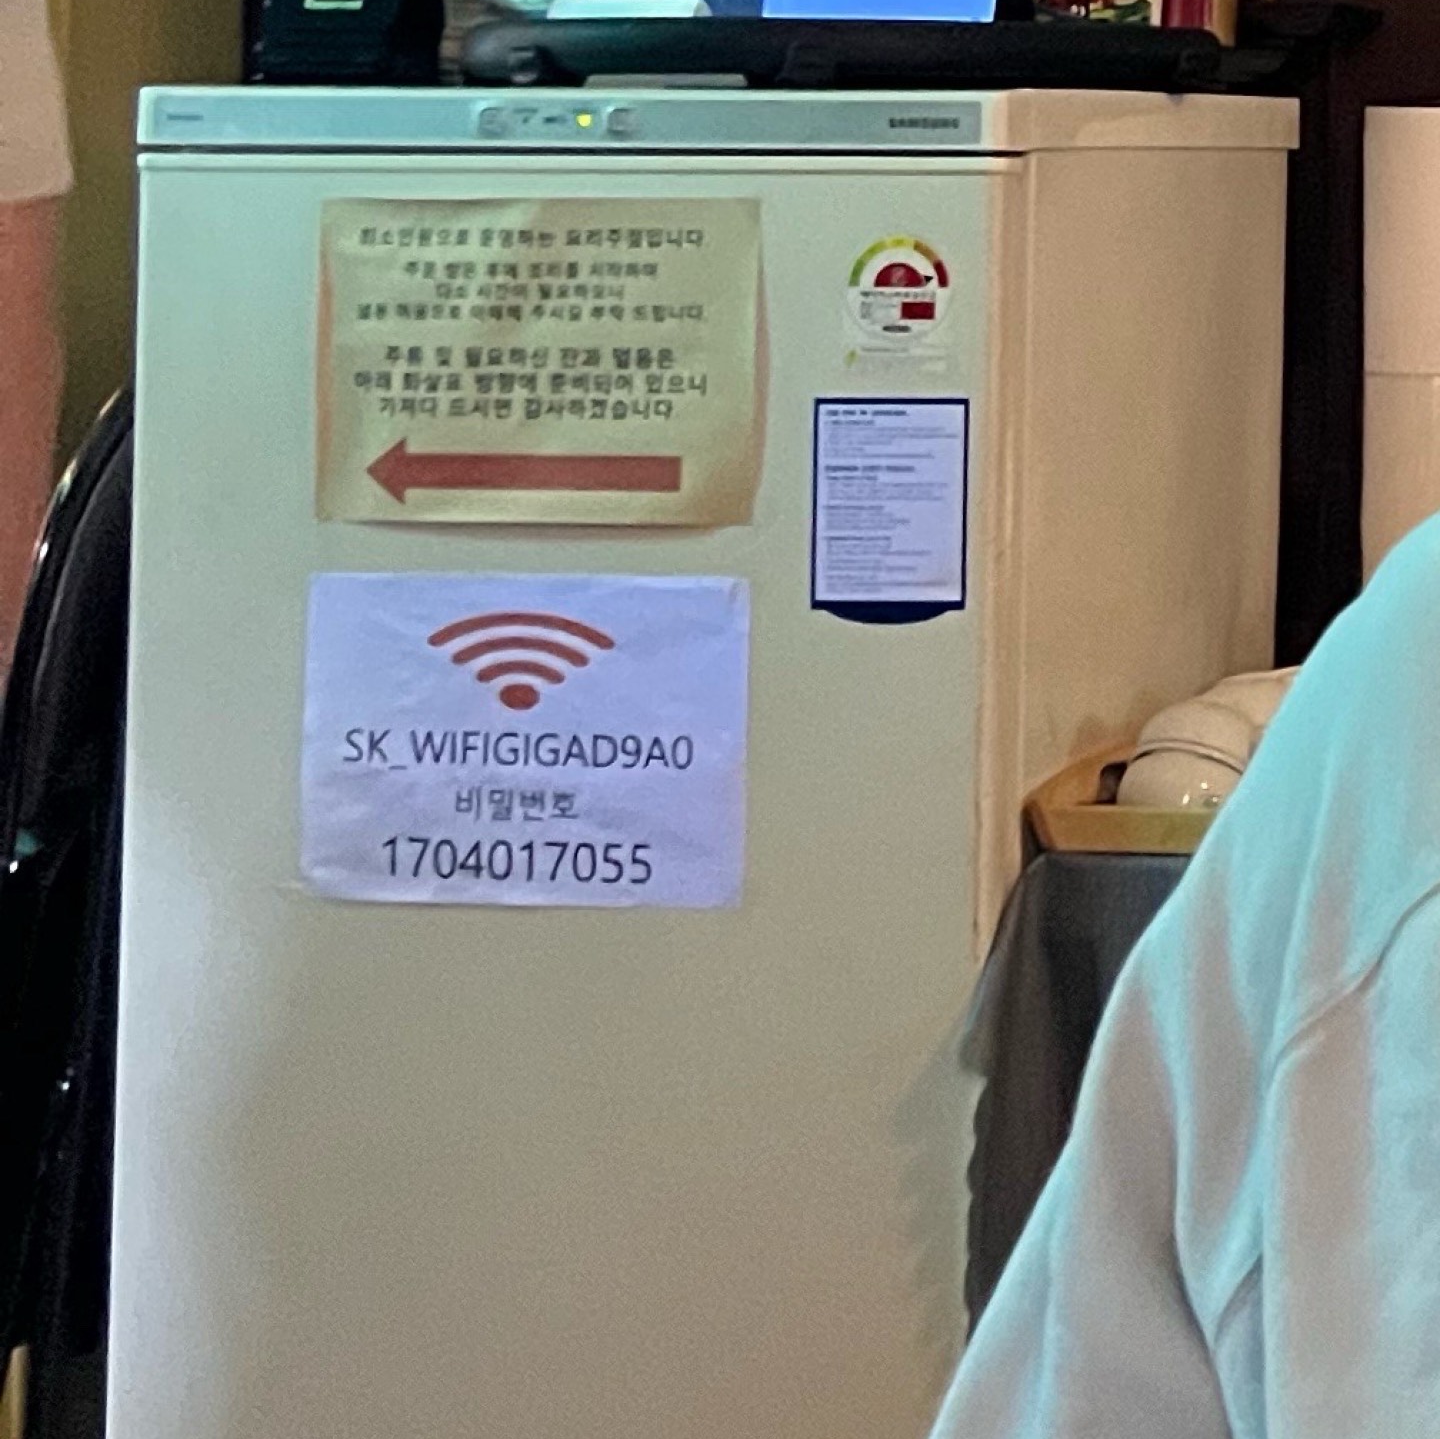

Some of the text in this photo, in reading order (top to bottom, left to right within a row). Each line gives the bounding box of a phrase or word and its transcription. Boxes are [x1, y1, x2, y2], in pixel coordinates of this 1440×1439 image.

[341, 727, 694, 772] SK_WIFIGIGAD9A0
[454, 787, 580, 821] 비밀번호
[381, 835, 654, 886] 1704017055
